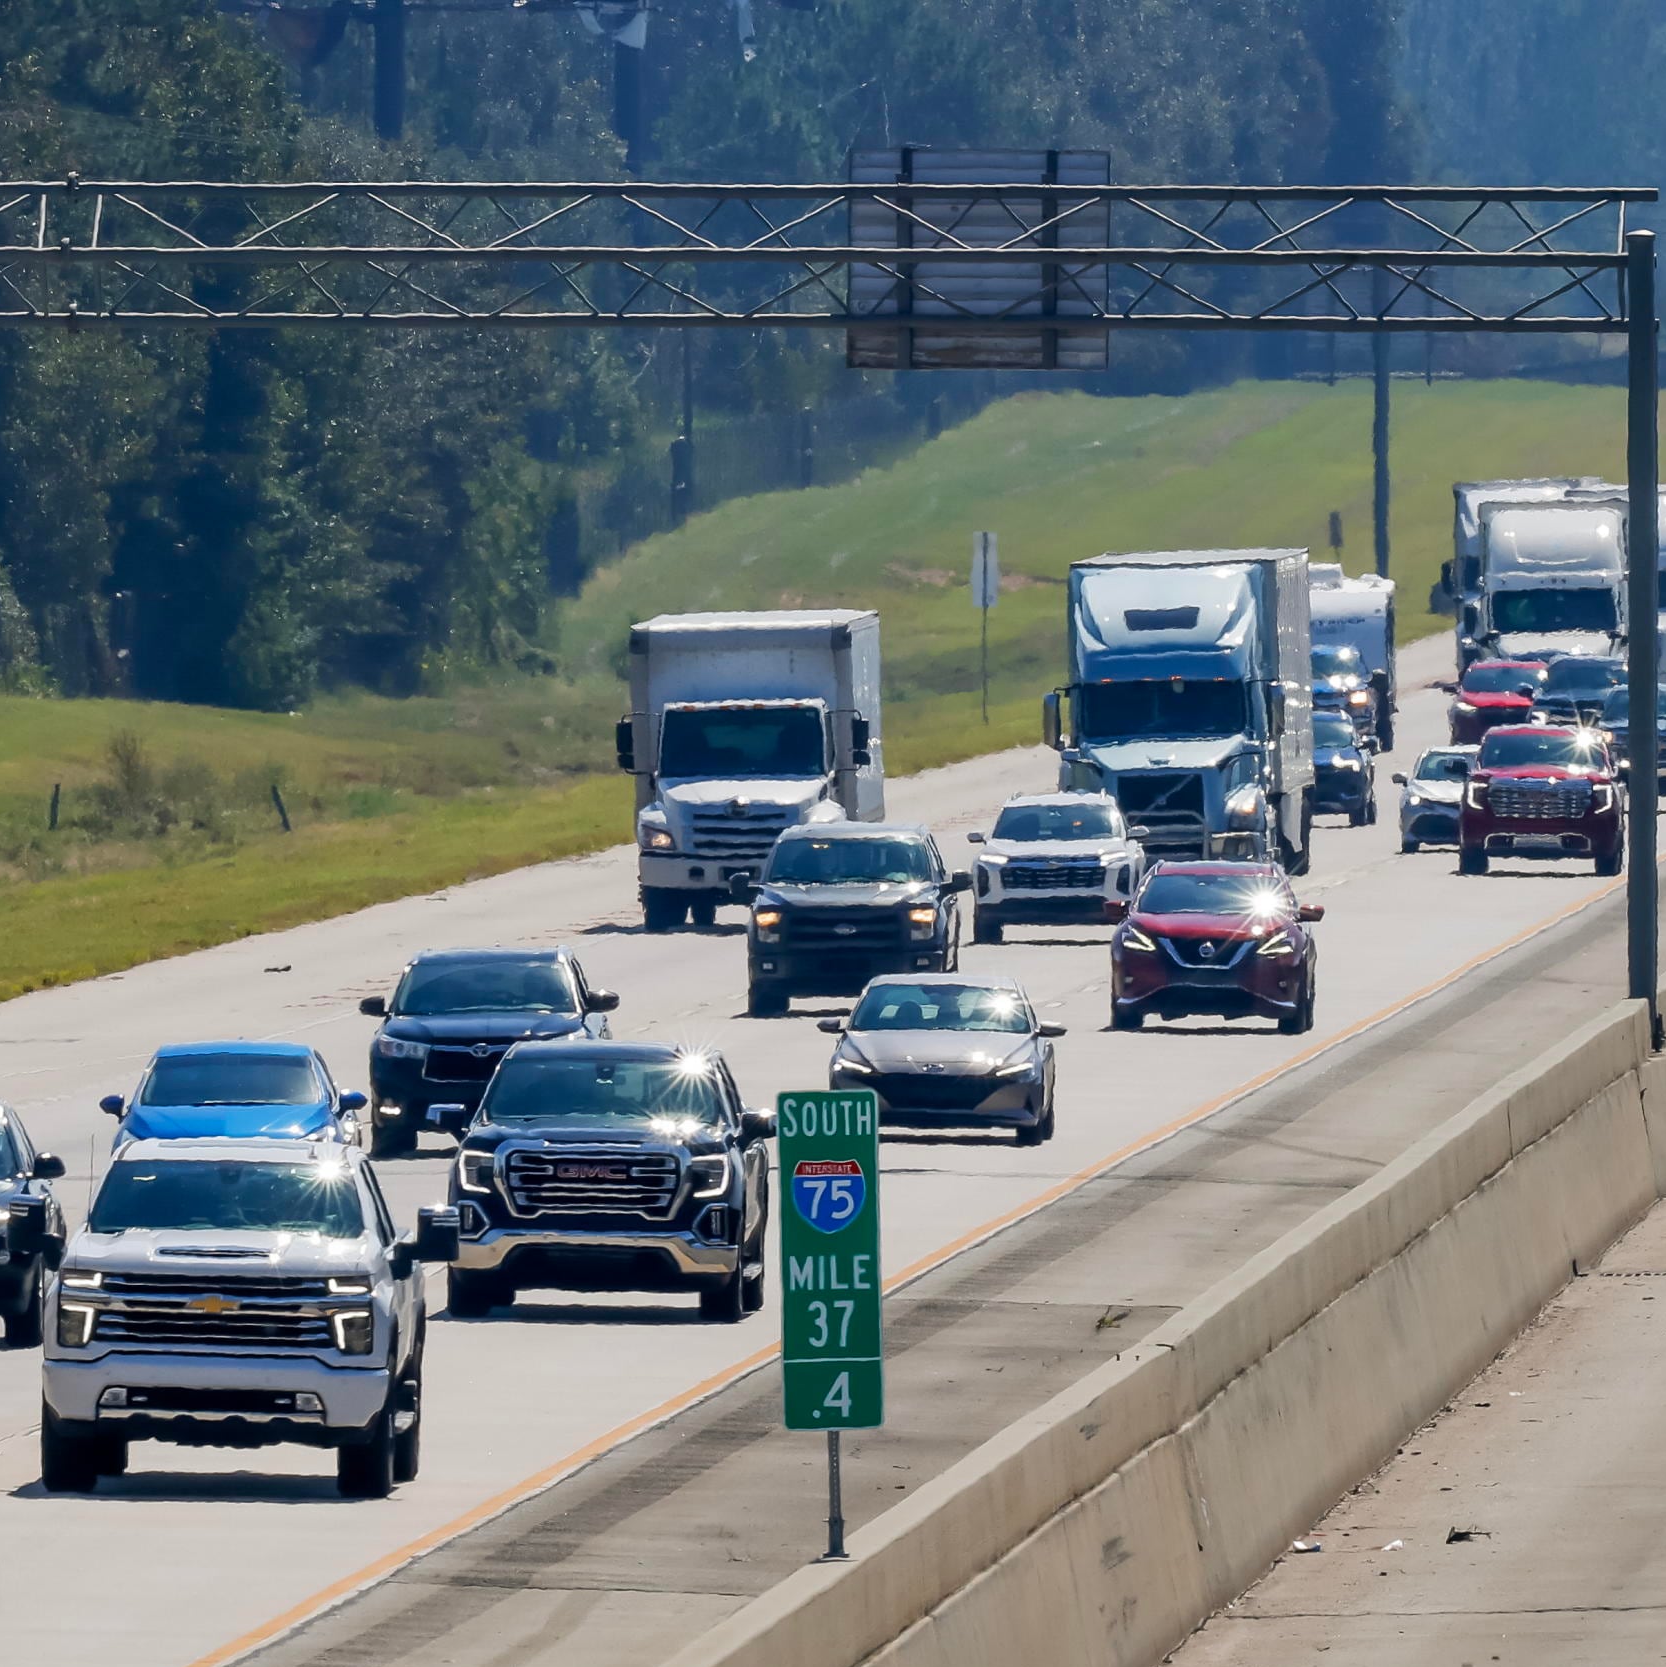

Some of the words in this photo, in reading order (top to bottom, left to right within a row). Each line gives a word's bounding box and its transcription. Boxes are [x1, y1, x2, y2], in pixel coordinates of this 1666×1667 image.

[783, 1098, 872, 1137] SOUTH
[556, 1163, 627, 1179] GMC
[801, 1163, 853, 1175] INTERSTATE
[802, 1179, 855, 1220] 75
[789, 1254, 871, 1291] MILE
[808, 1300, 854, 1348] 37
[812, 1370, 852, 1418] .4
